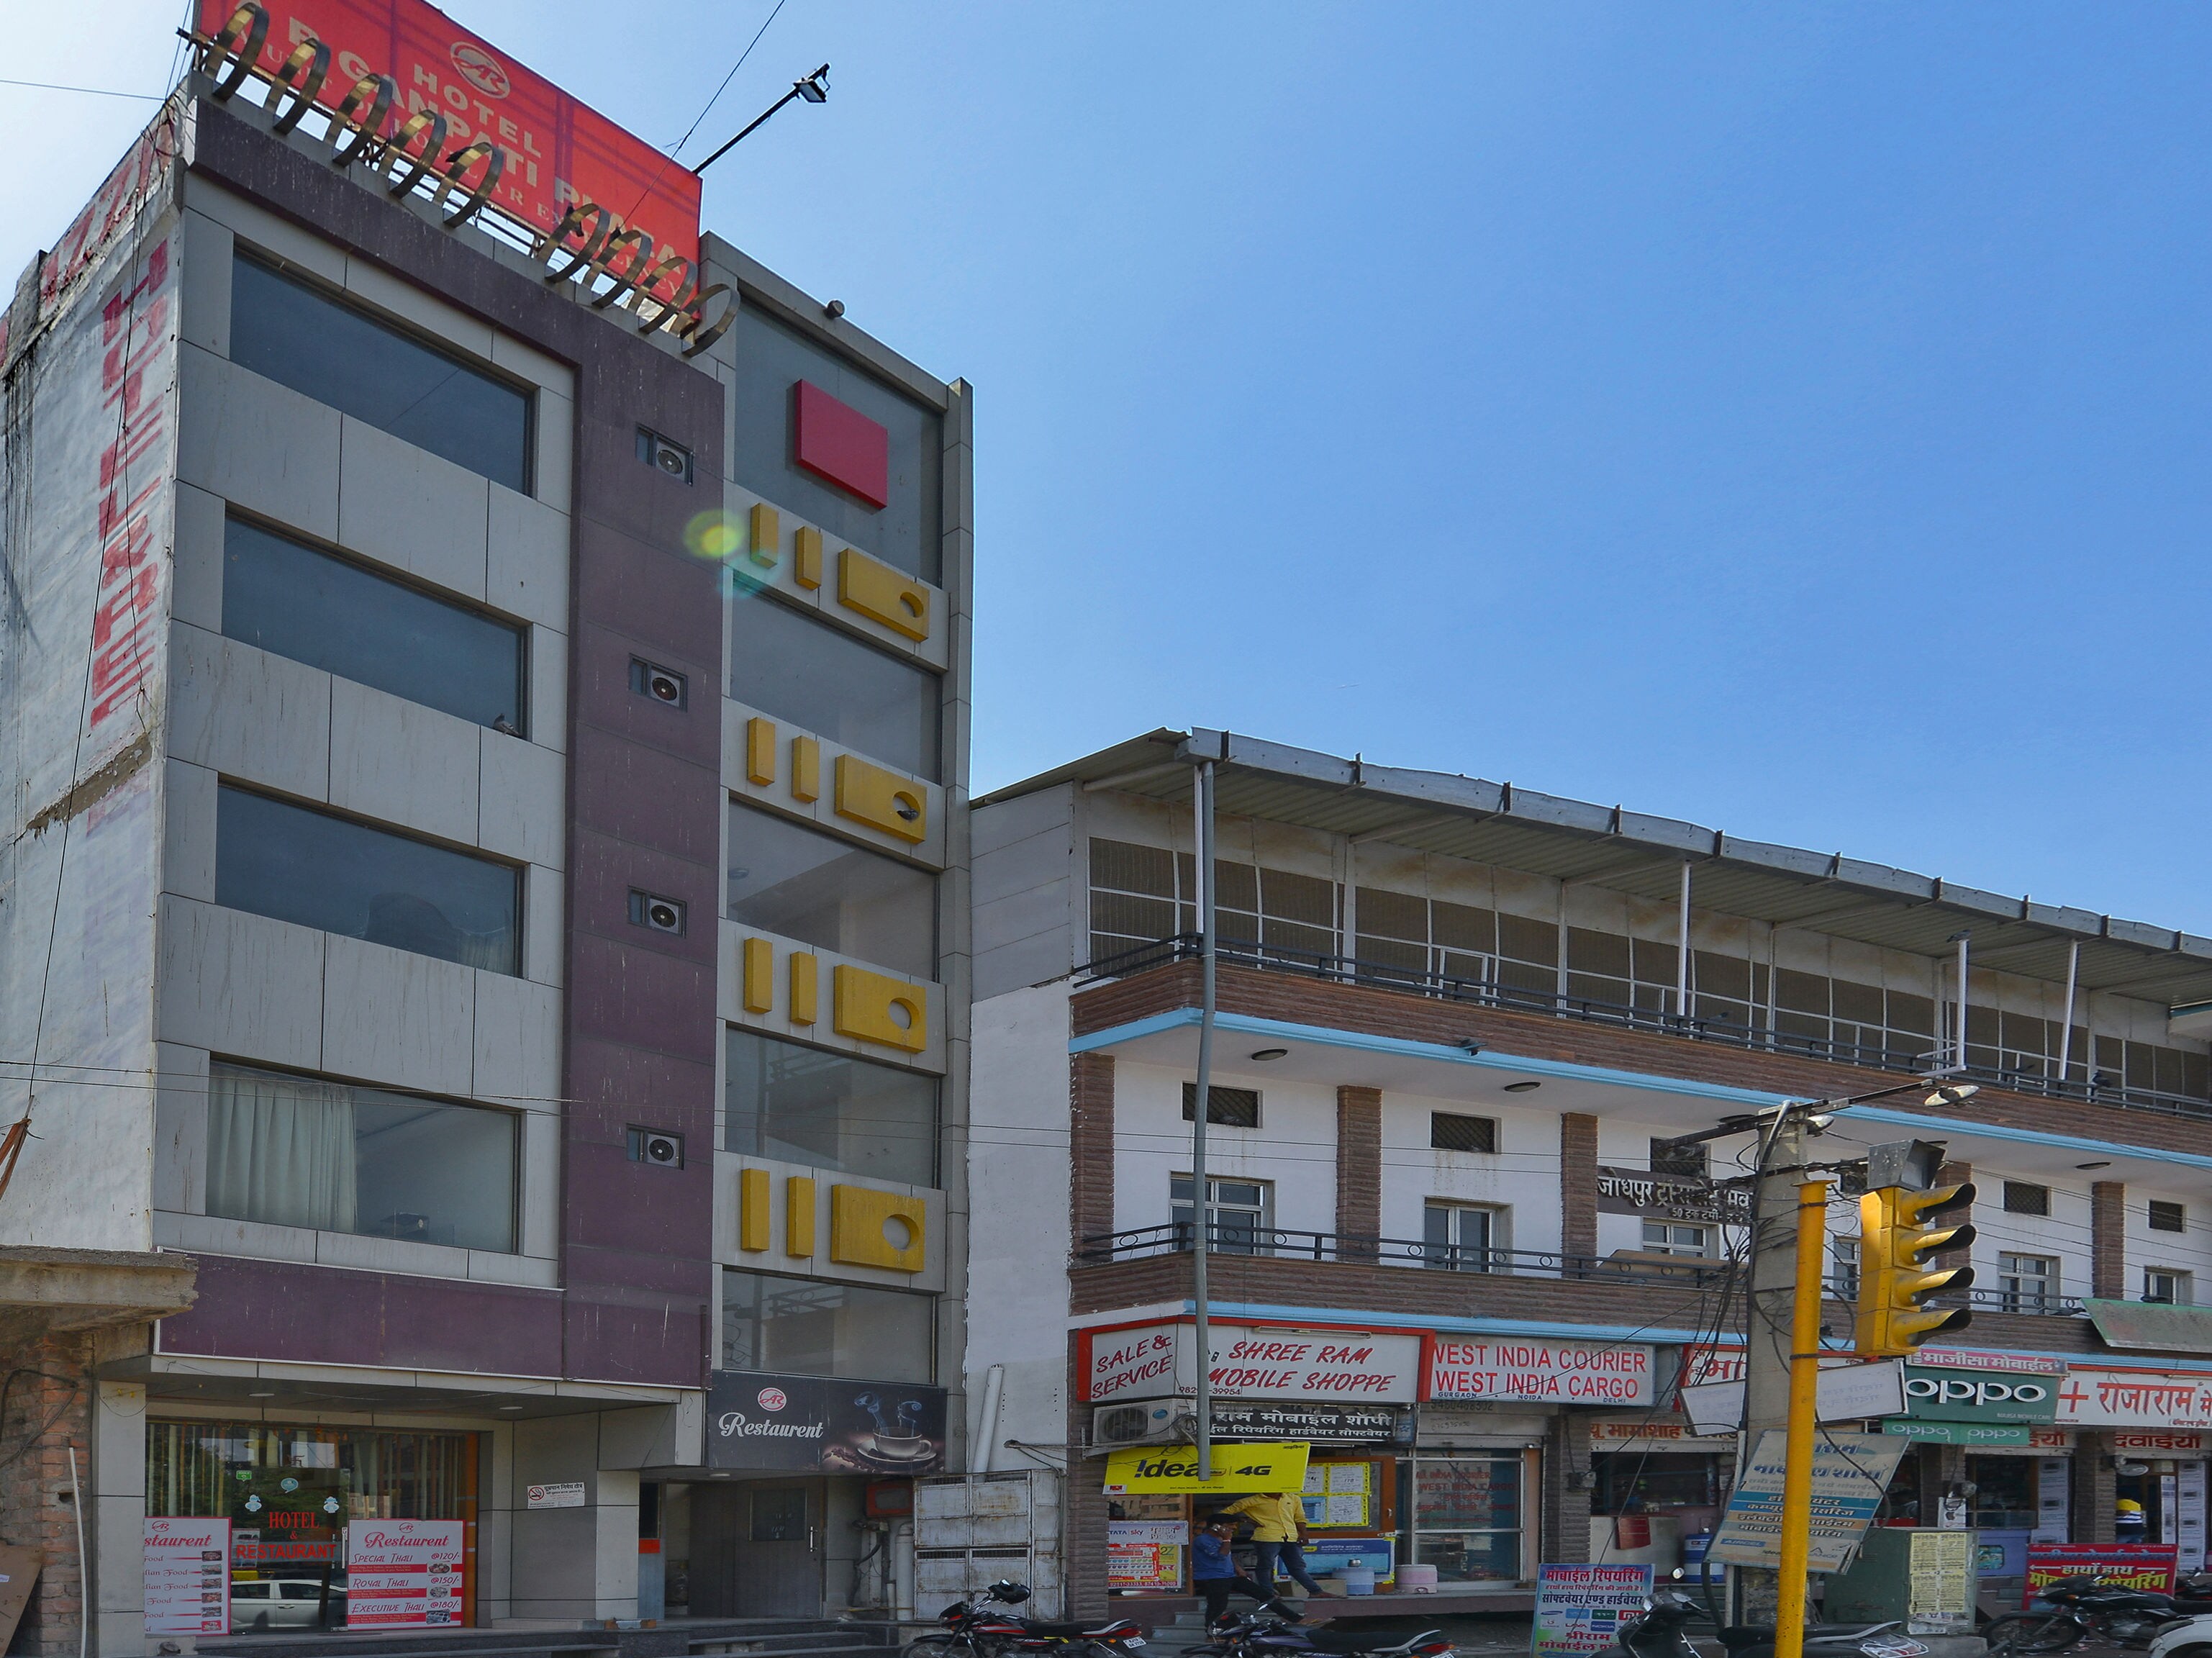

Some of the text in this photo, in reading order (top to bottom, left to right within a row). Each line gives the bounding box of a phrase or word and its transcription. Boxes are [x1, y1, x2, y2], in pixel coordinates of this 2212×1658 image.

[413, 63, 542, 159] HOTEL
[1096, 1335, 1172, 1373] SALE &
[1228, 1341, 1373, 1364] SHREE RAM
[1497, 1346, 1552, 1369] INDIA
[1559, 1348, 1647, 1373] COURIER
[1092, 1354, 1174, 1399] SERVICE
[1208, 1367, 1397, 1392] MOBILE SHOPPE
[1436, 1370, 1638, 1399] WEST INDIA CARGO
[1905, 1378, 2047, 1405] oppo
[2096, 1382, 2196, 1417] राजाराम
[718, 1412, 824, 1439] Restaurent
[1967, 1428, 2021, 1439] oppo
[1235, 1465, 1272, 1476] 4G
[268, 1511, 319, 1528] HOTEL
[289, 1531, 297, 1539] &
[364, 1531, 450, 1548] Restaurent
[236, 1544, 337, 1559] RESTAURANT
[1546, 1567, 1645, 1583] मोबाईल रिपेयरिंग
